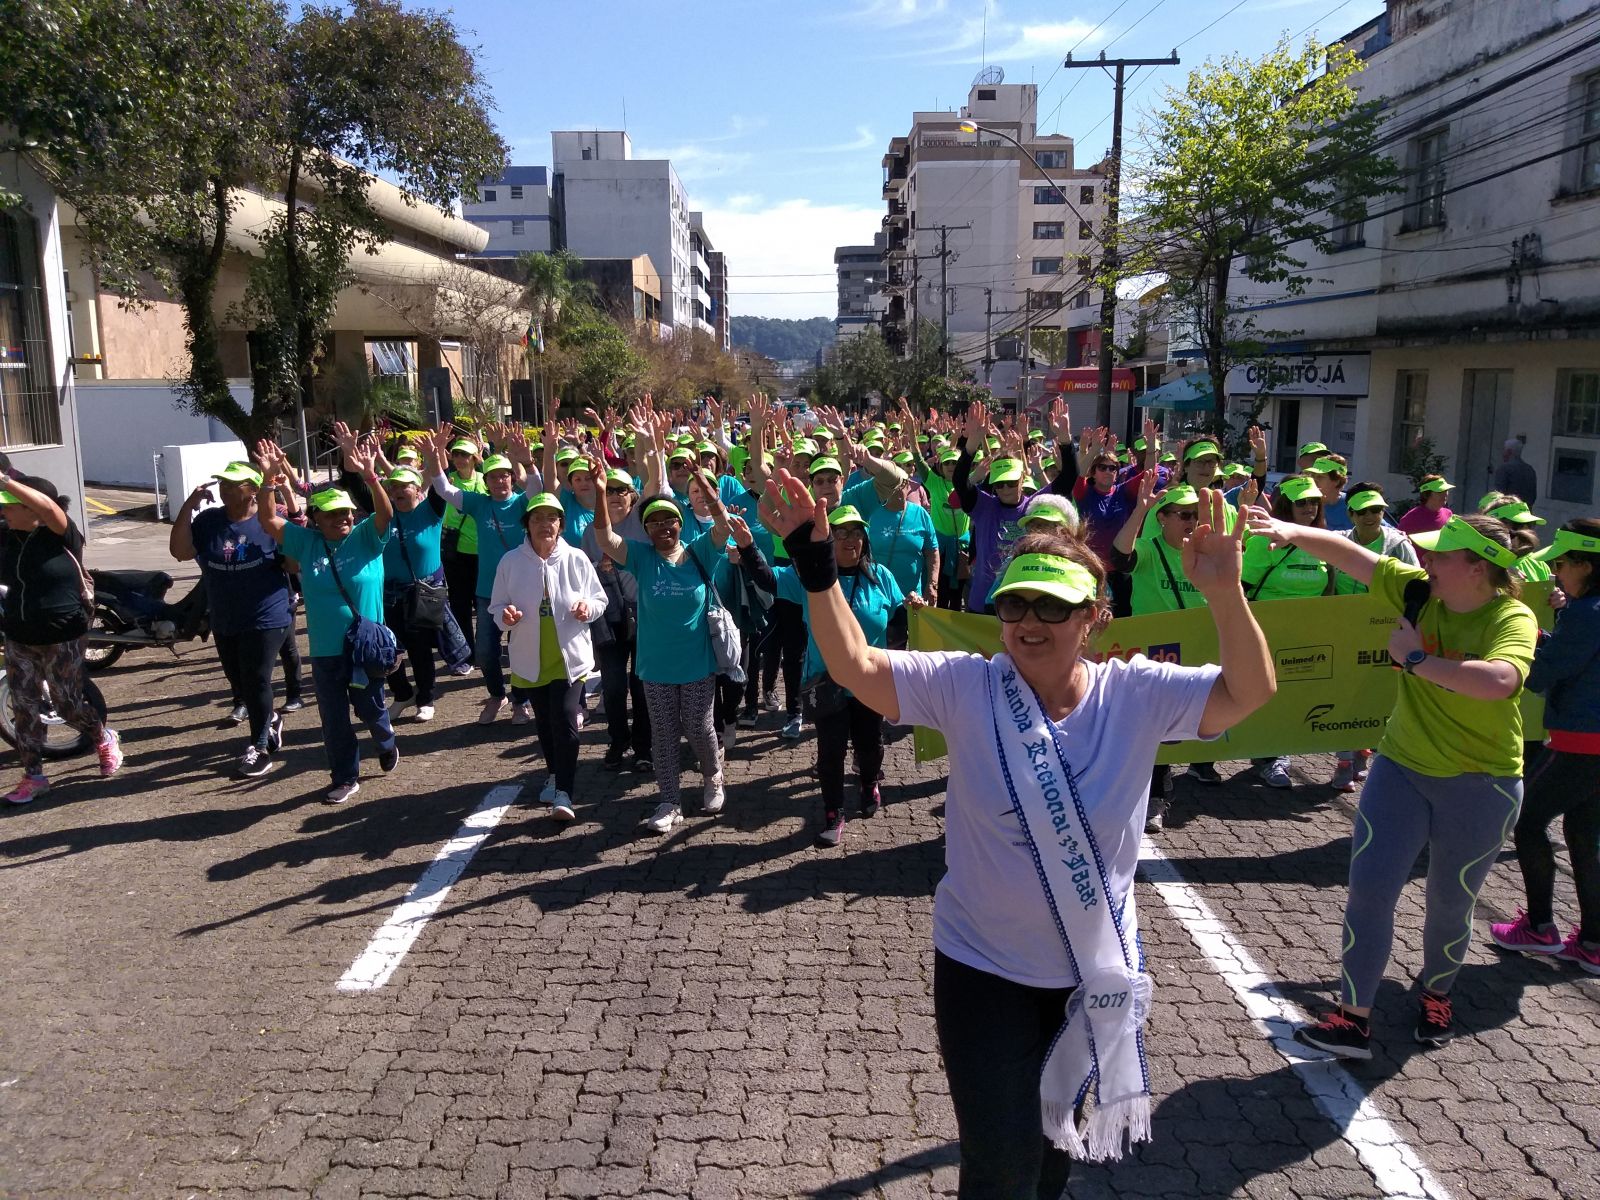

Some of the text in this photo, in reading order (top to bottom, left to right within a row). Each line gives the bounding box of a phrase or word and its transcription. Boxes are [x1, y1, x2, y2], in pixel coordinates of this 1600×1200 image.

[1319, 360, 1346, 383] JÁ
[1152, 648, 1178, 664] do
[1281, 655, 1314, 666] Unimed
[1311, 717, 1380, 733] Fecomércio
[1001, 664, 1032, 733] Rainha
[1022, 738, 1070, 835] Regional
[1061, 853, 1097, 911] Idade
[1089, 991, 1128, 1009] 2019
